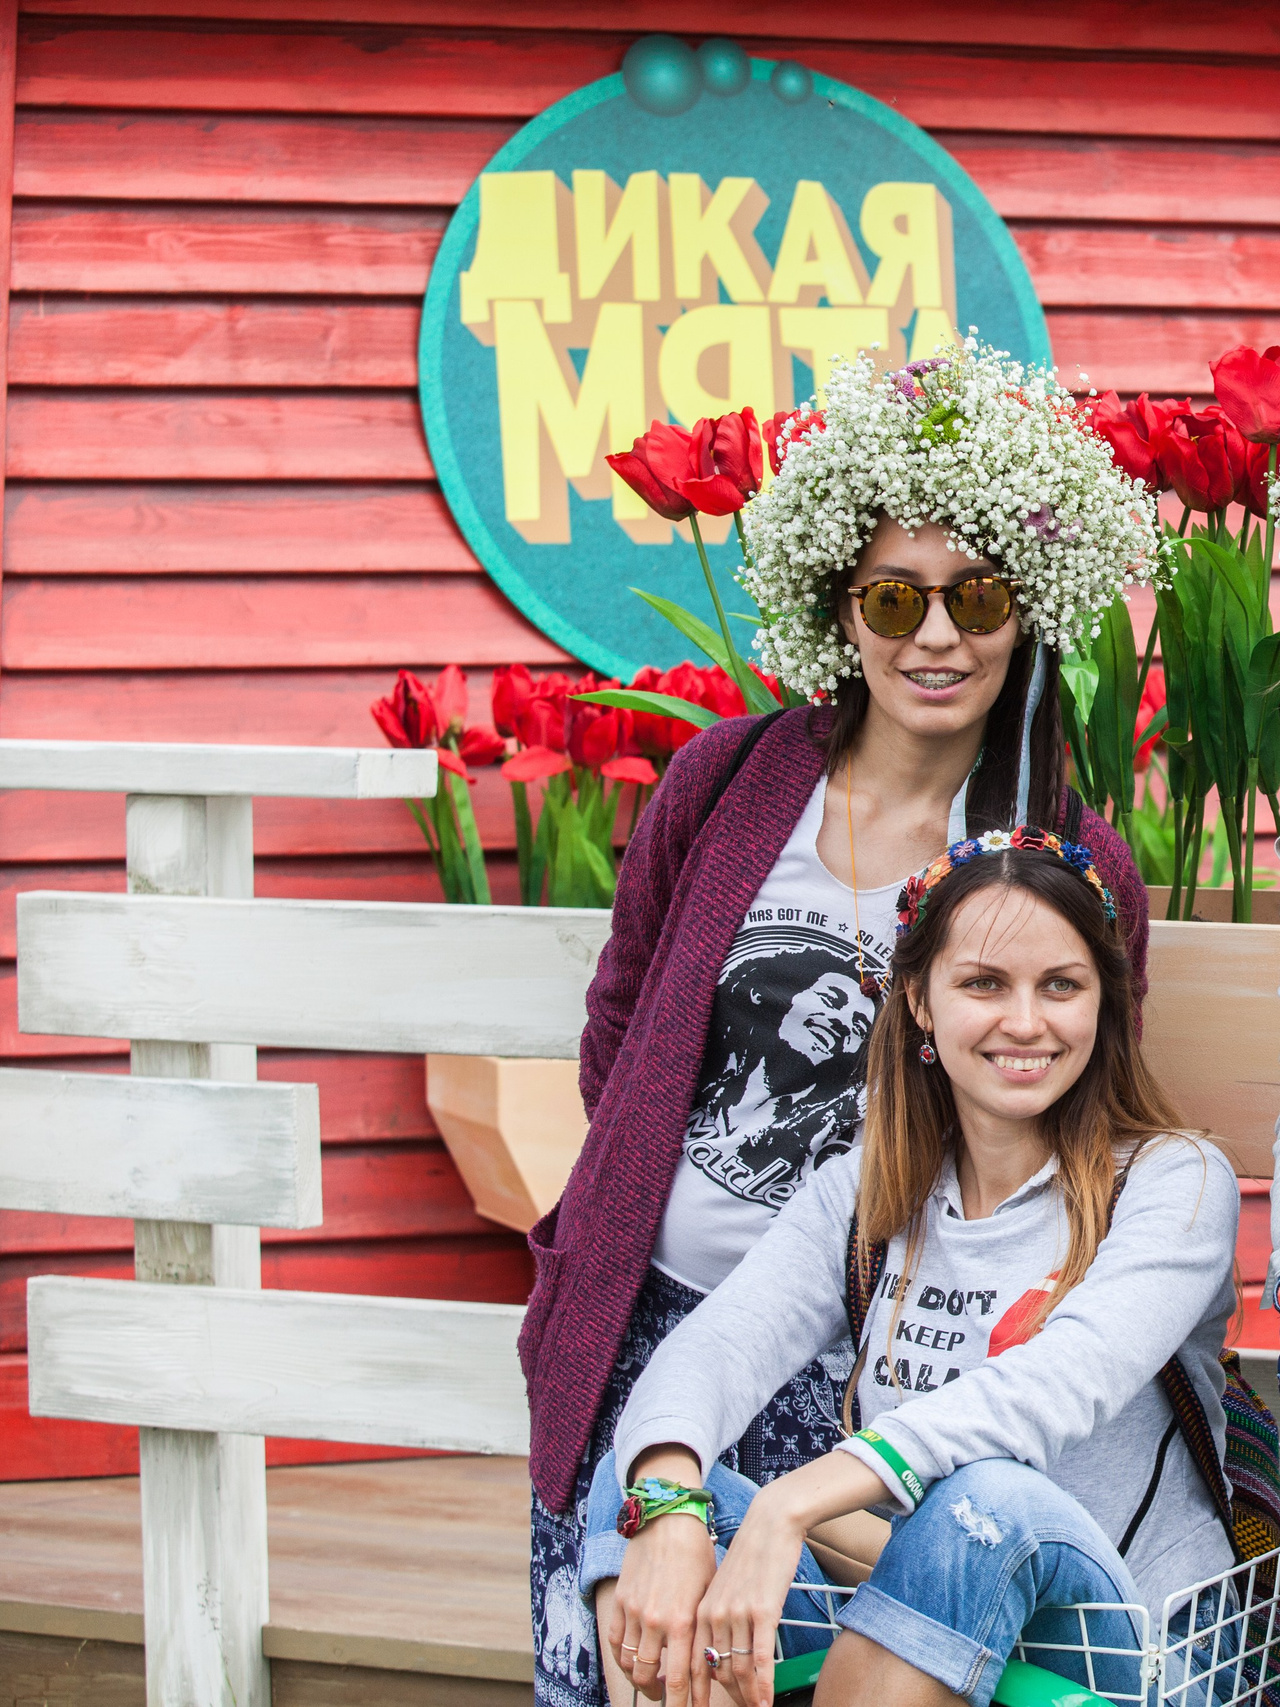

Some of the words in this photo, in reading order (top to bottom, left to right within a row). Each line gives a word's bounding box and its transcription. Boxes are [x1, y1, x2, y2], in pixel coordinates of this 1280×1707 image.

[459, 169, 950, 325] ДИКАЯ
[748, 908, 773, 923] HAS
[777, 908, 802, 922] GOT
[806, 910, 828, 927] ME
[855, 929, 874, 947] SO
[683, 1106, 796, 1212] Marle
[896, 1319, 966, 1352] KEEP
